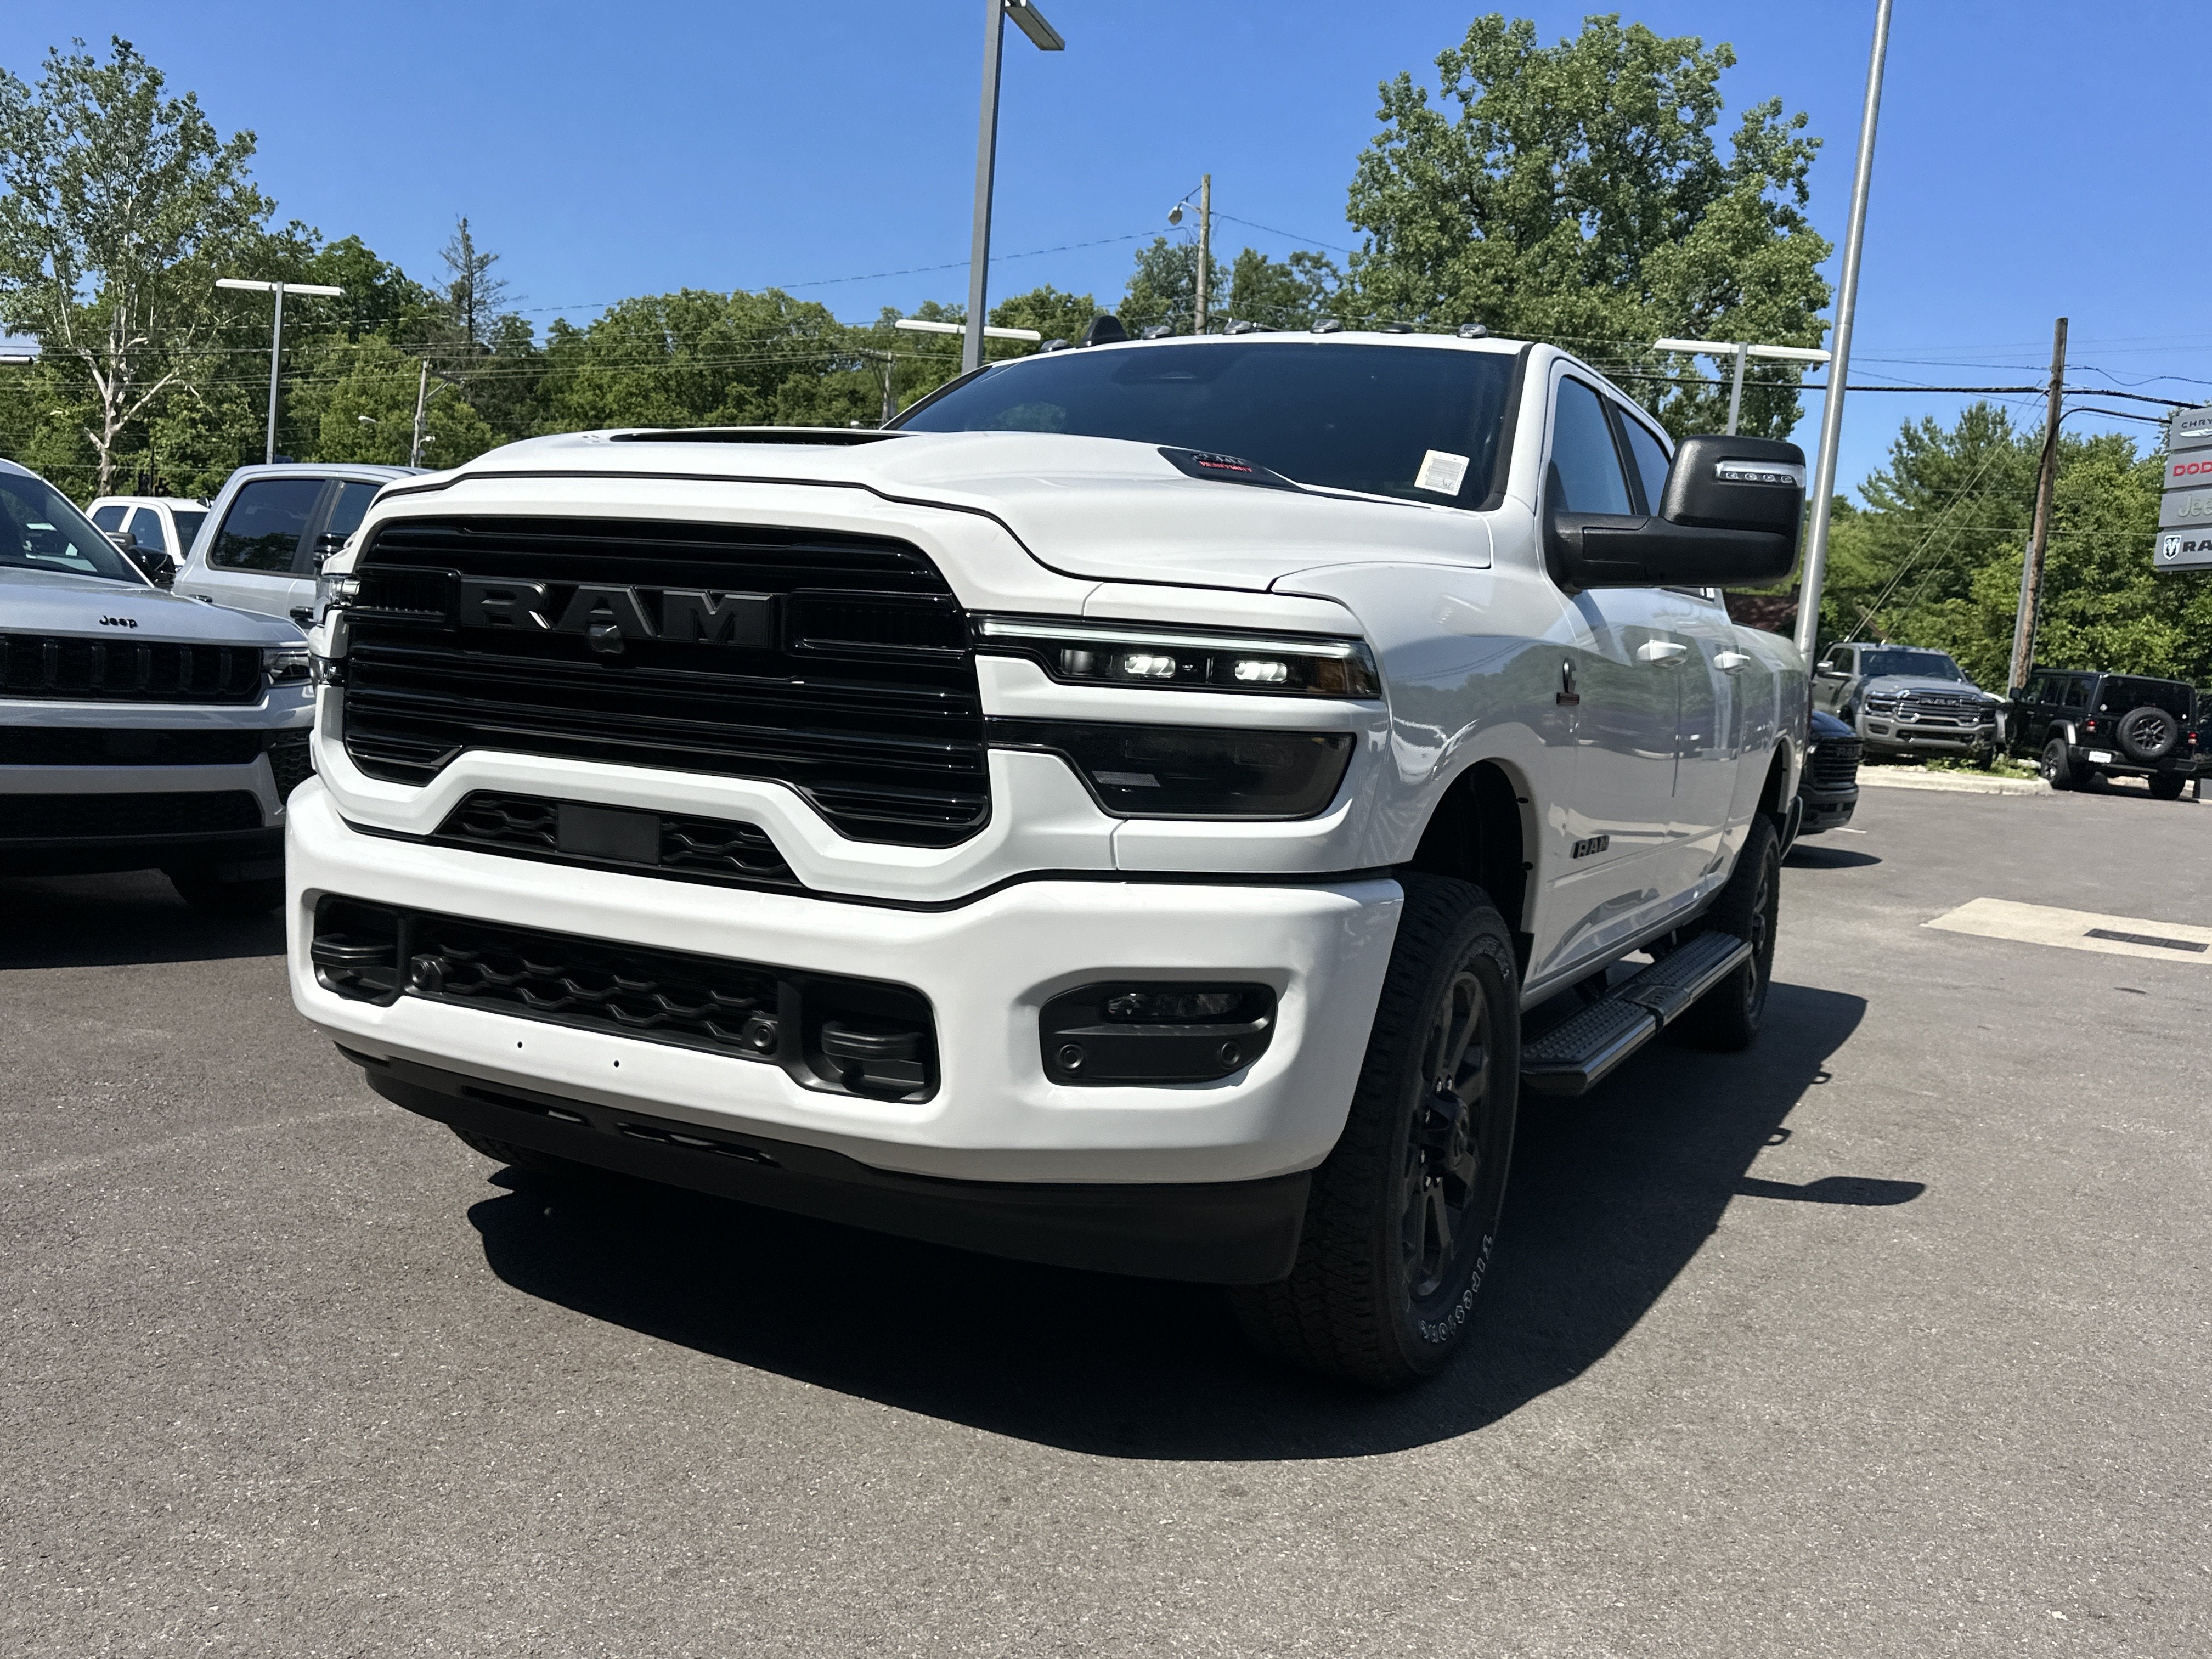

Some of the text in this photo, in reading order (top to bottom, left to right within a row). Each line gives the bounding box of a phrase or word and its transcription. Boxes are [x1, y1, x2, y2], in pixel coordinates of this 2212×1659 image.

[2173, 461, 2212, 476] DOD
[2182, 540, 2212, 552] RA
[460, 574, 774, 647] RAM
[99, 614, 138, 629] Jeep
[1573, 836, 1610, 859] RAM
